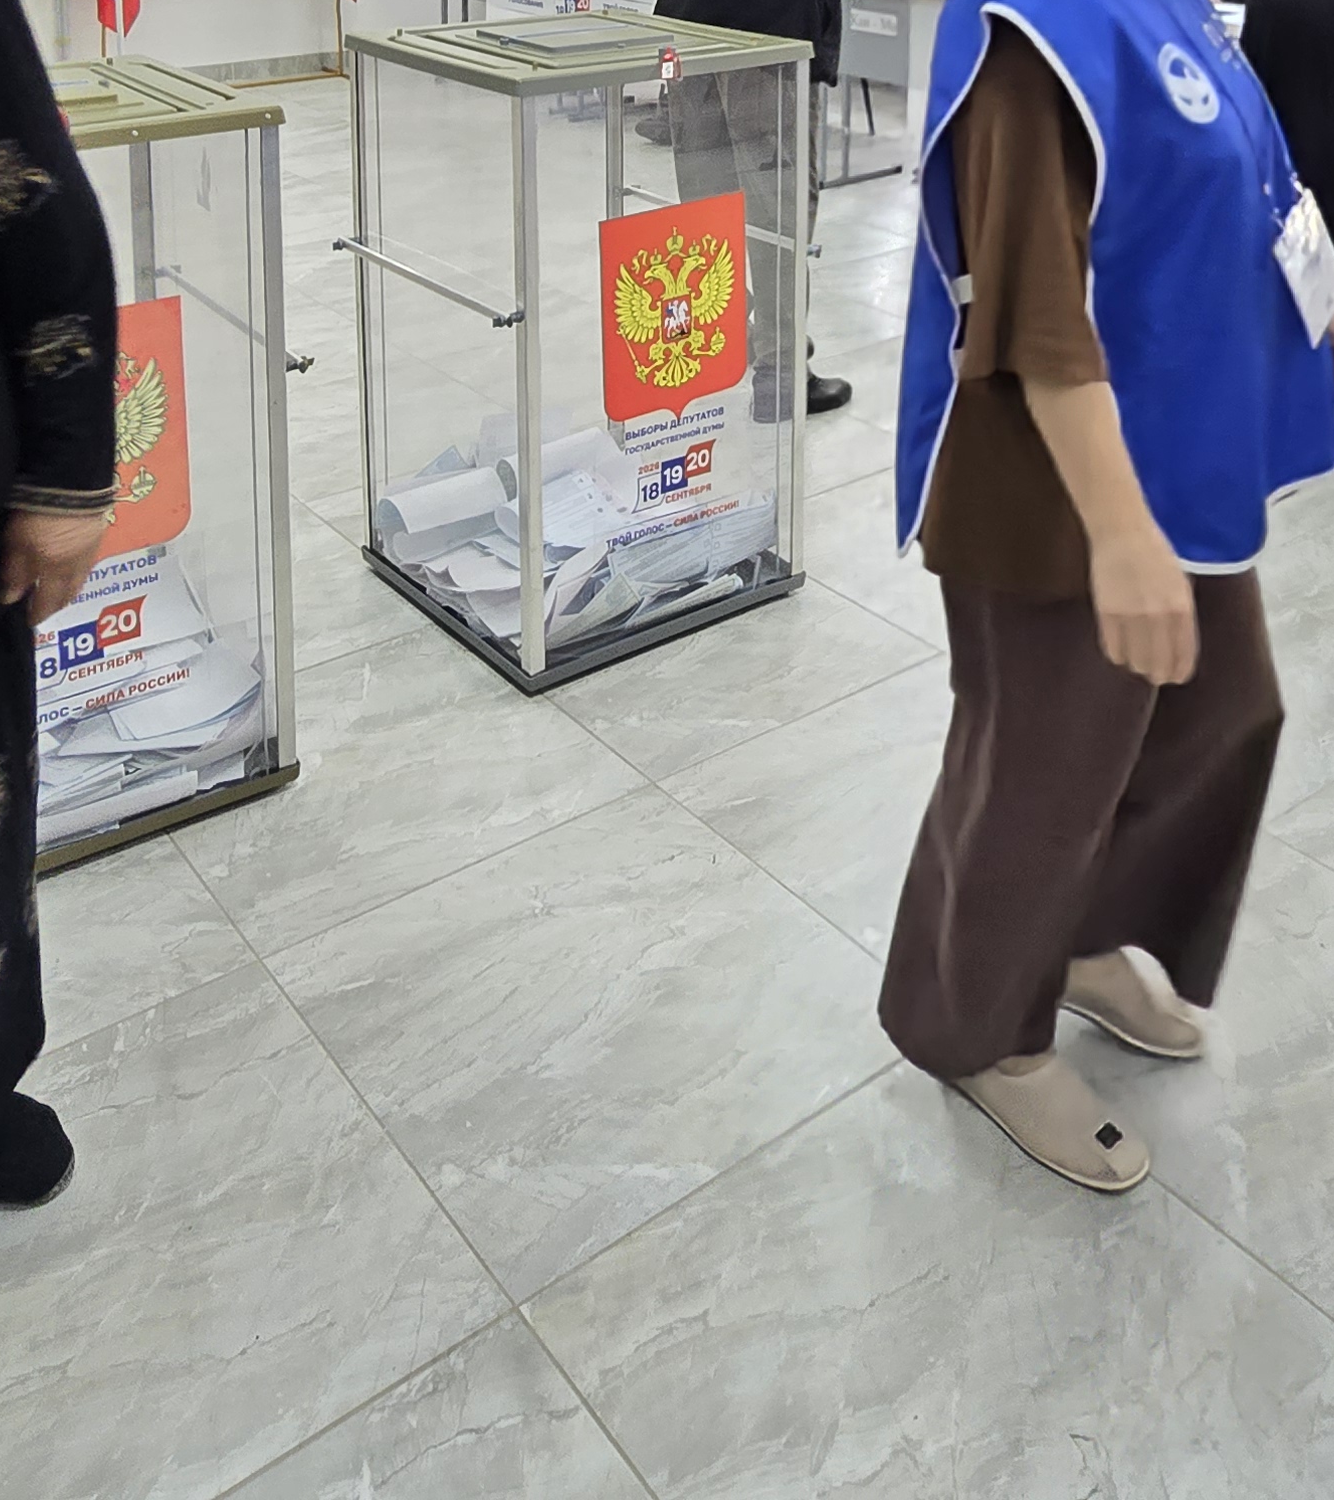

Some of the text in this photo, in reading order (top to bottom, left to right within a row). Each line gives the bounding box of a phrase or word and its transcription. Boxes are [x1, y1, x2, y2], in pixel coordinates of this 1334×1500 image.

[625, 406, 725, 441] ВЫБОРЫ ДЕПУТАТОВ
[625, 422, 725, 455] ГОСУДАРСТВЕННОЙ ДУМЫ
[638, 461, 660, 475] 2026
[641, 449, 710, 503] 18 19 20
[665, 483, 712, 504] СЕНТЯБРЯ
[605, 531, 633, 549] ТВОЙ
[633, 523, 665, 542] ГОЛОС
[673, 511, 699, 528] СИЛА
[700, 500, 740, 520] РОССИИ!
[88, 554, 158, 582] ПУТАТОВ
[122, 572, 158, 592] ДУМЫ
[35, 631, 56, 644] 26
[39, 608, 137, 680] 8 19 20
[68, 651, 144, 682] СЕНТЯБРЯ
[37, 706, 70, 726] ЛОС
[85, 689, 126, 711] СИЛА
[128, 667, 191, 696] РОССИИ!
